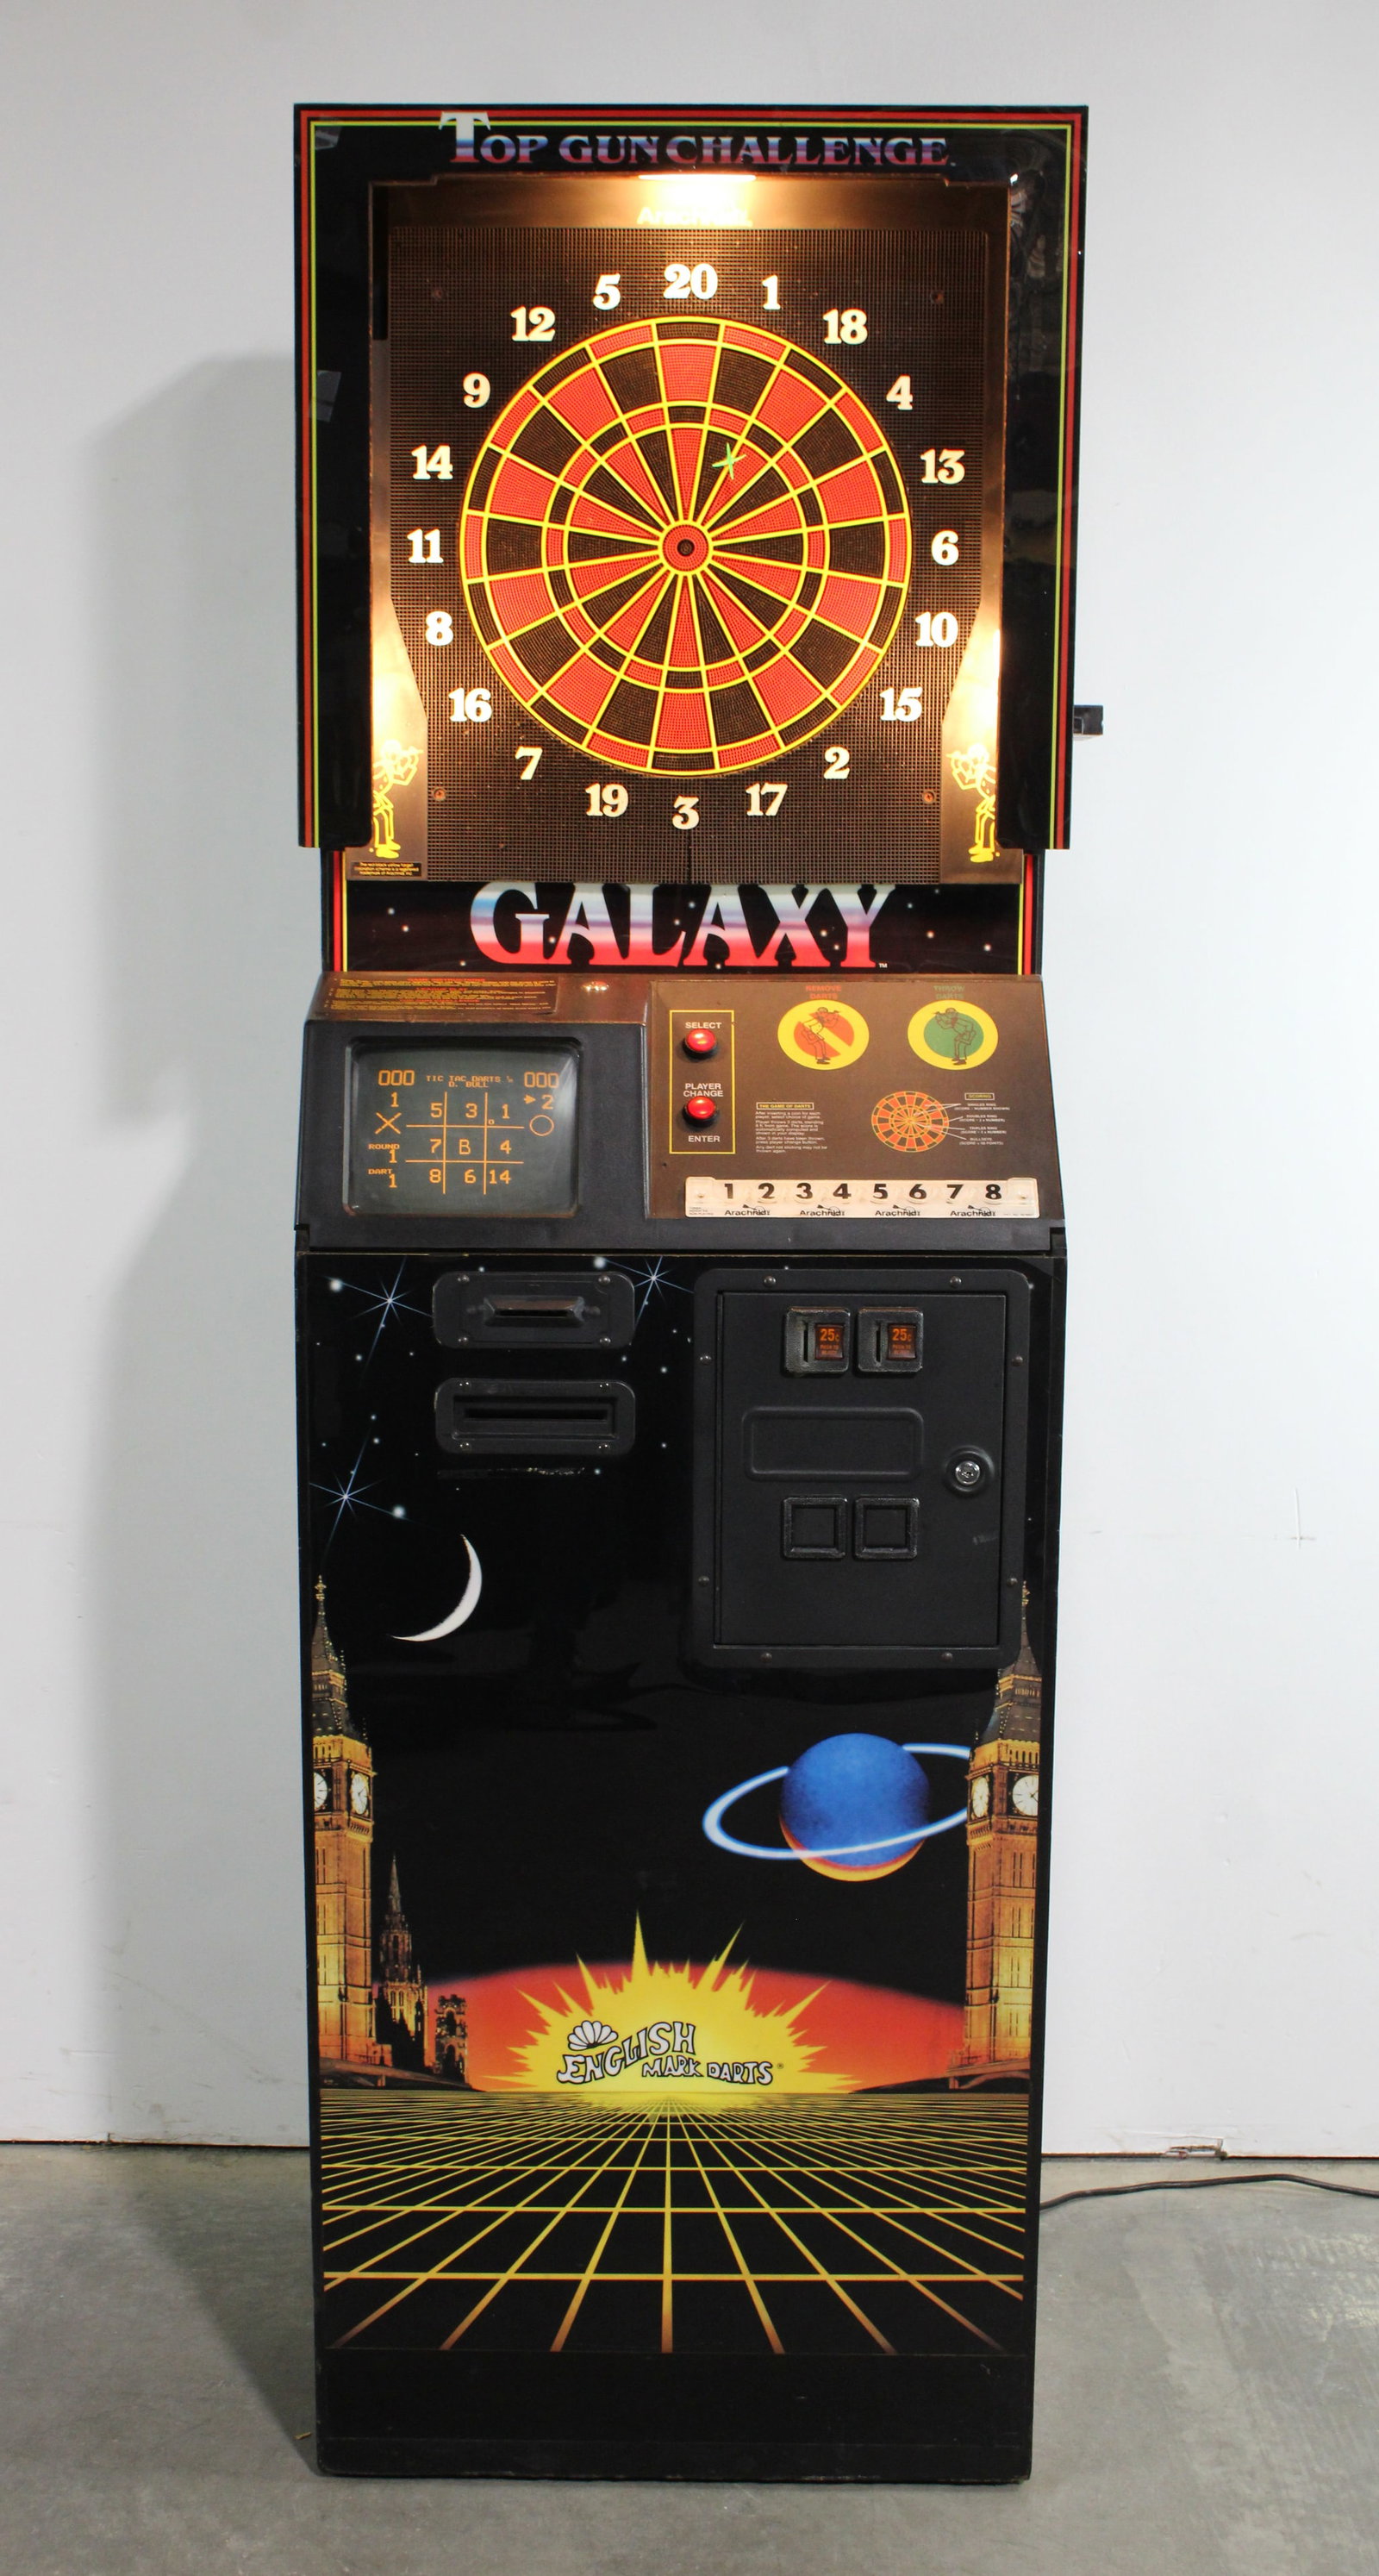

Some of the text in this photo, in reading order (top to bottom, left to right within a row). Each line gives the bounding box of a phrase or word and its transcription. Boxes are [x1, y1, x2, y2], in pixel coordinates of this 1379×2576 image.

[438, 110, 949, 166] TOP GUN CHALLENGE
[593, 272, 621, 310] 5
[663, 262, 719, 300] 20
[762, 275, 781, 310] 1
[510, 306, 556, 342] 12
[822, 309, 868, 345] 18
[463, 372, 490, 409] 9
[886, 375, 914, 410] 4
[411, 445, 453, 481] 14
[920, 449, 966, 485] 13
[407, 528, 444, 564] 11
[931, 530, 959, 566] 6
[426, 610, 454, 646] 8
[915, 611, 959, 647] 10
[449, 687, 493, 723] 16
[879, 687, 923, 722] 15
[515, 747, 543, 780] 7
[823, 747, 850, 780] 2
[585, 783, 629, 817] 19
[672, 796, 700, 830] 3
[746, 783, 788, 817] 17
[470, 881, 895, 968] GALAXY
[378, 1069, 415, 1086] 000
[523, 1072, 560, 1088] 000
[390, 1091, 399, 1108] 1
[430, 1102, 443, 1118] 5
[465, 1103, 478, 1118] 3
[502, 1104, 510, 1119] 1
[541, 1094, 554, 1110] 2
[389, 1148, 397, 1163] 1
[429, 1139, 441, 1154] 7
[459, 1139, 471, 1155] B
[499, 1140, 512, 1154] 4
[389, 1173, 397, 1188] 1
[429, 1169, 441, 1184] 8
[464, 1169, 477, 1184] 6
[489, 1169, 512, 1185] 14
[724, 1182, 1002, 1200] 1 2 3 4 5 6 7 8
[556, 2021, 696, 2085] ENGLISH
[641, 2054, 774, 2085] MARK DARTS
